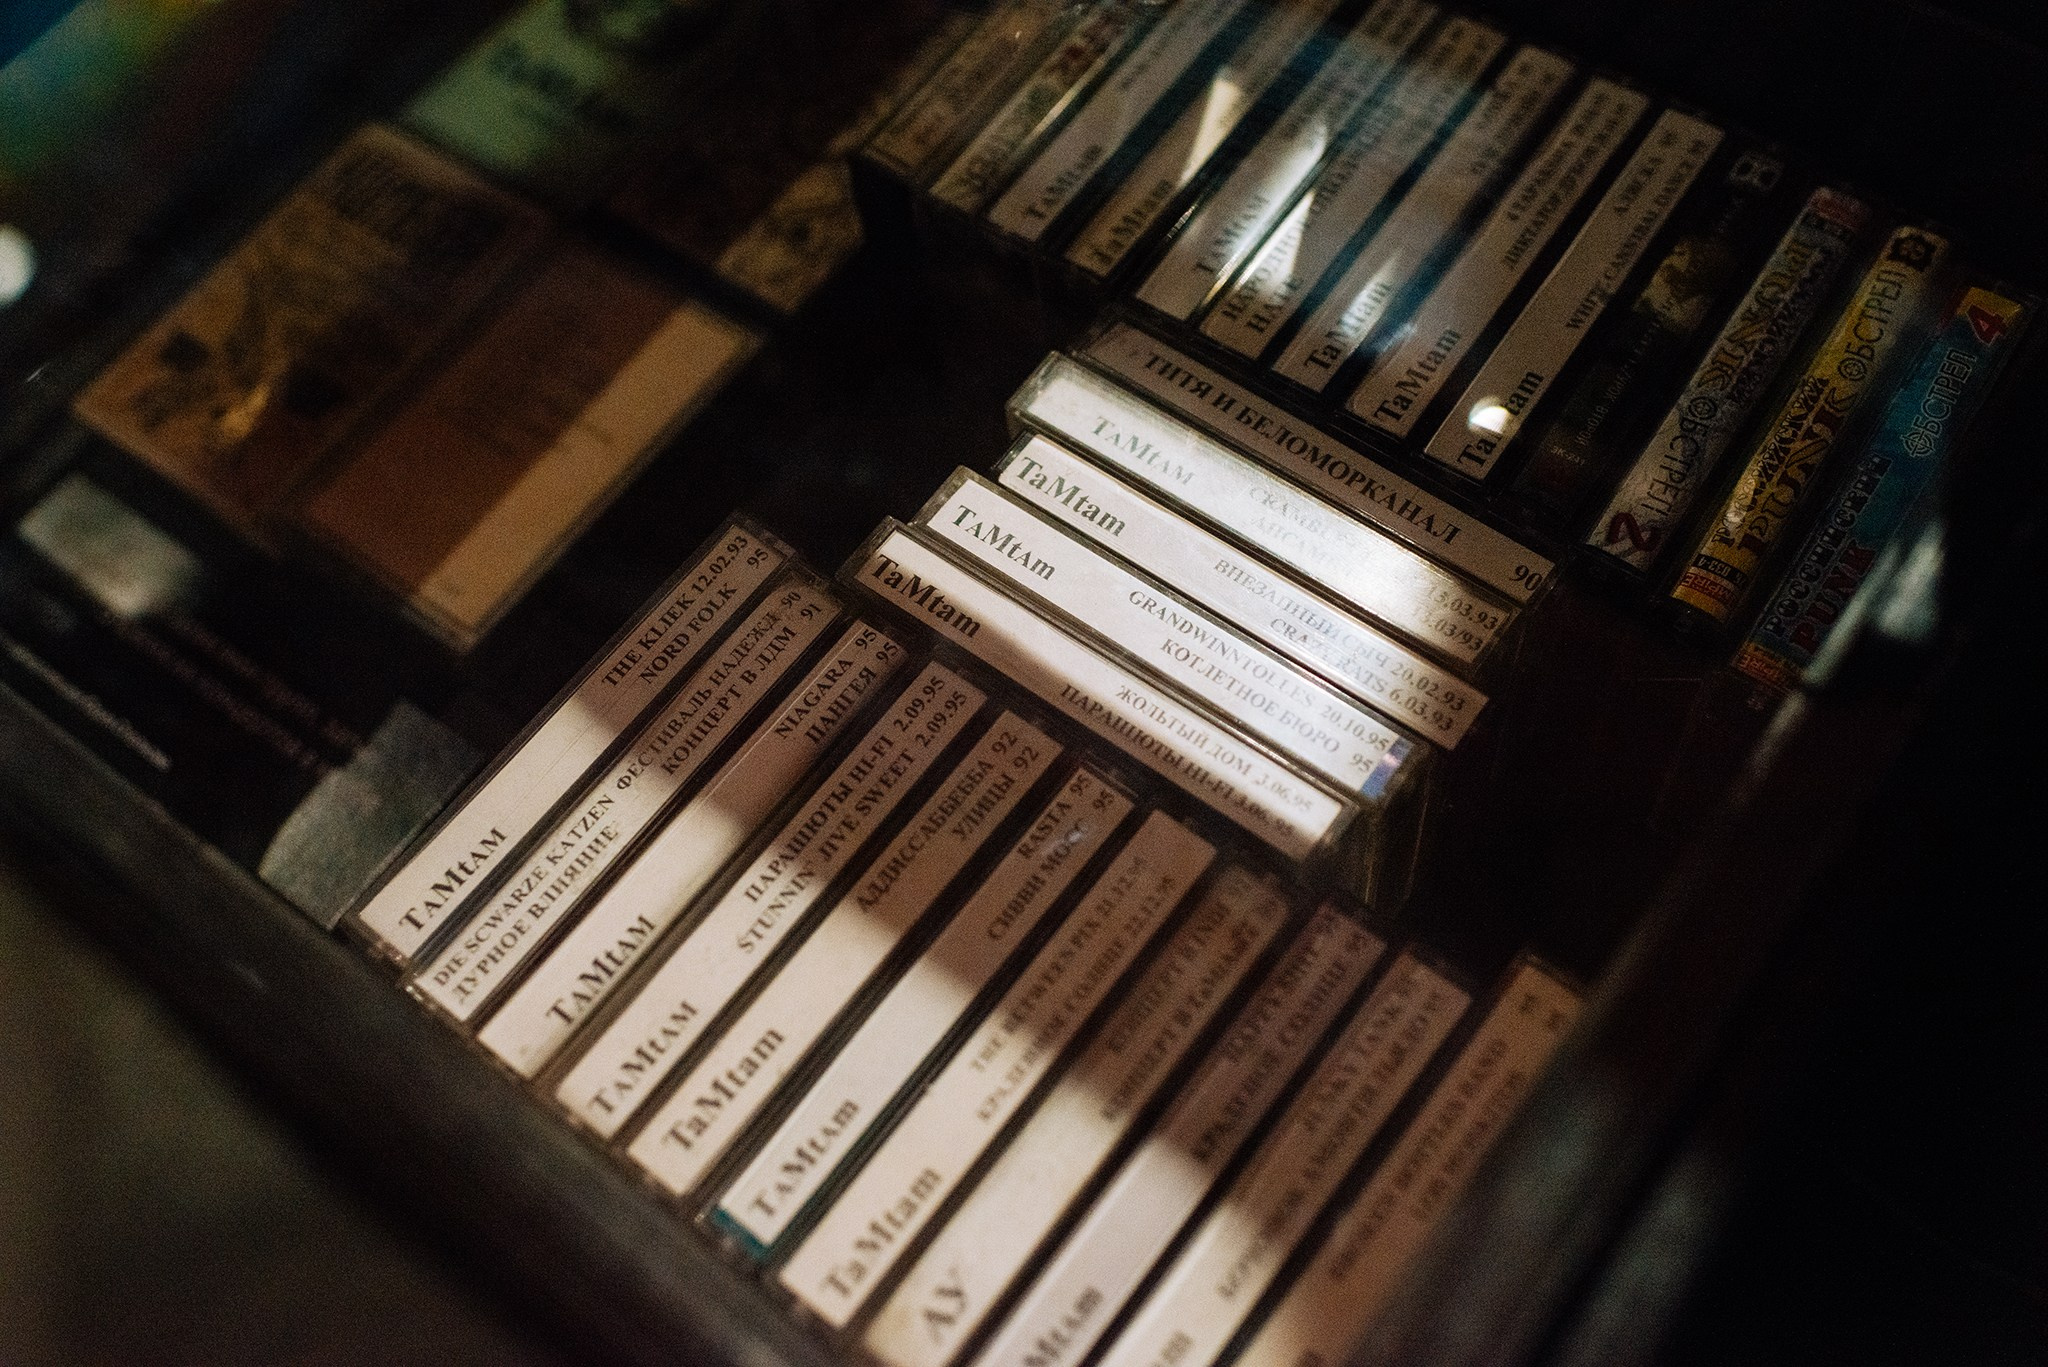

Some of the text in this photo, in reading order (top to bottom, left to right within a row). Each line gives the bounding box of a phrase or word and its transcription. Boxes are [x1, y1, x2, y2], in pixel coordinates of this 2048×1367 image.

[1957, 299, 2011, 349] 4
[1455, 366, 1544, 476] Tatam
[1734, 381, 1858, 561] PUNK
[1012, 455, 1128, 538] TaMtam
[1234, 403, 1461, 546] БЕЛОМОРКАНАЛ
[1508, 562, 1544, 594] 90
[600, 532, 751, 691] THE KLIEK 12.02.93
[638, 544, 771, 686] NORD FOLK 95
[866, 551, 983, 641] TaMtam
[773, 625, 880, 741] NIAGARA 95
[803, 638, 901, 745] ПАНГЕЯ 95
[1058, 682, 1188, 770] ПАРАШЮТЫ
[1113, 682, 1211, 750] ЖОЛЬТЫЙ
[1204, 738, 1254, 778] ДОМ
[1159, 637, 1375, 776] КОТЛЕТНОЕ БЮРО 95
[1317, 701, 1390, 754] 20.10.95
[1386, 683, 1456, 734] 6.03.93
[1387, 658, 1467, 714] 20.02.93
[743, 672, 946, 905] ПАРАШЮТЫ HI-FI 2.09.95
[853, 746, 918, 818] SWEET
[912, 687, 969, 750] 2.09.95
[950, 742, 1041, 844] УЛИЦЫ 92
[990, 727, 1019, 758] 92
[432, 950, 469, 988] DIE
[462, 863, 550, 954] SCWARZE
[544, 792, 616, 867] KATZEN
[613, 682, 713, 792] ФЕСТИВАЛЬ
[448, 598, 823, 1005] ДУРНОЕ ВЛИЯНИЕ КОНЦЕРТ В ЛДМ 91
[1016, 771, 1093, 861] RASTA 95
[1089, 786, 1117, 814] 95
[658, 1022, 787, 1160] TaMtam
